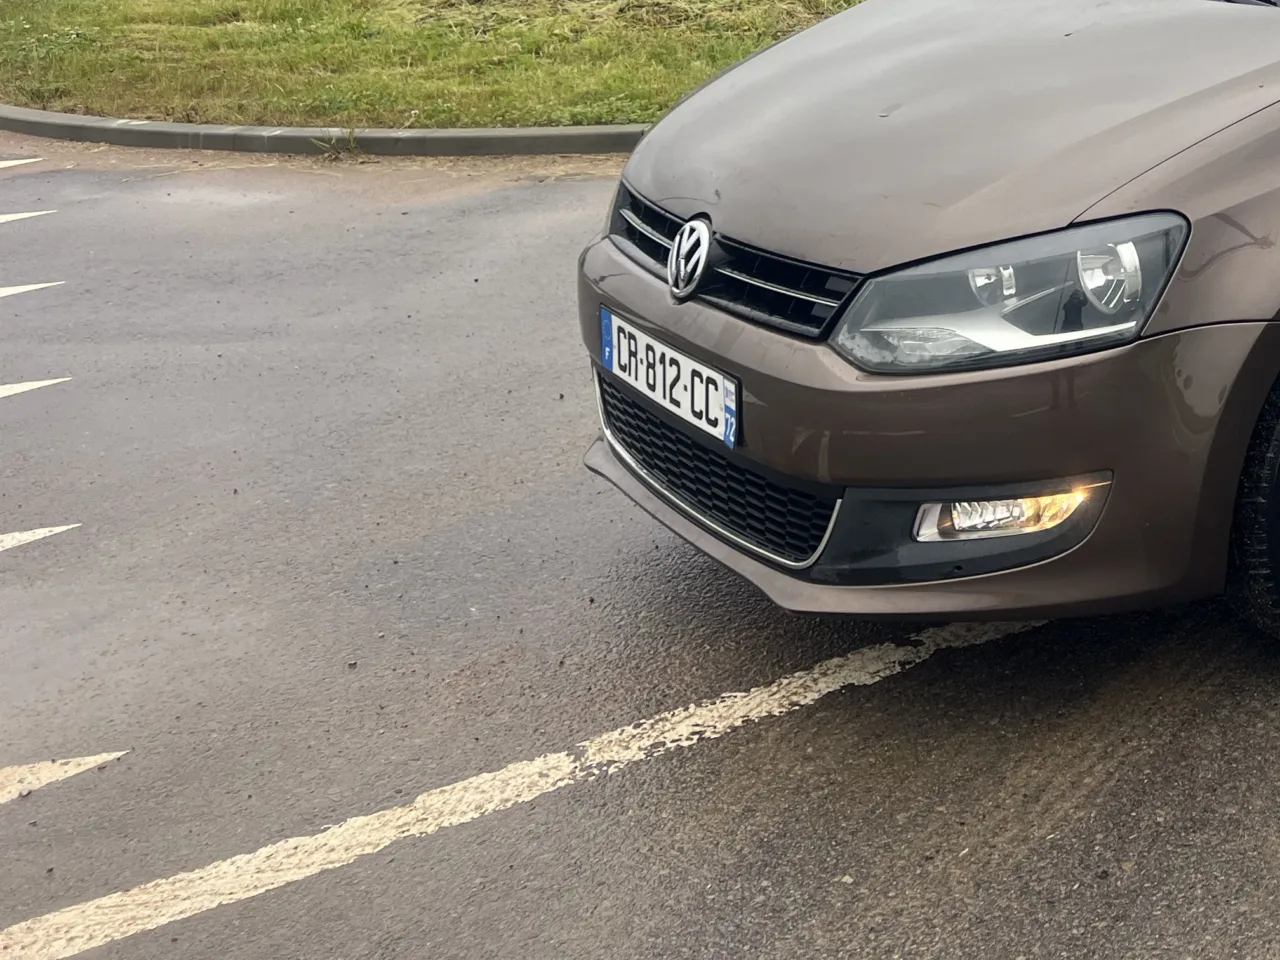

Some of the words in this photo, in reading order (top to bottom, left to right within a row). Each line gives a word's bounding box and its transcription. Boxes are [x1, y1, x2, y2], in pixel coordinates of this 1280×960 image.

[605, 346, 611, 360] F
[617, 325, 719, 429] CR-812-CC
[725, 411, 736, 443] 72
